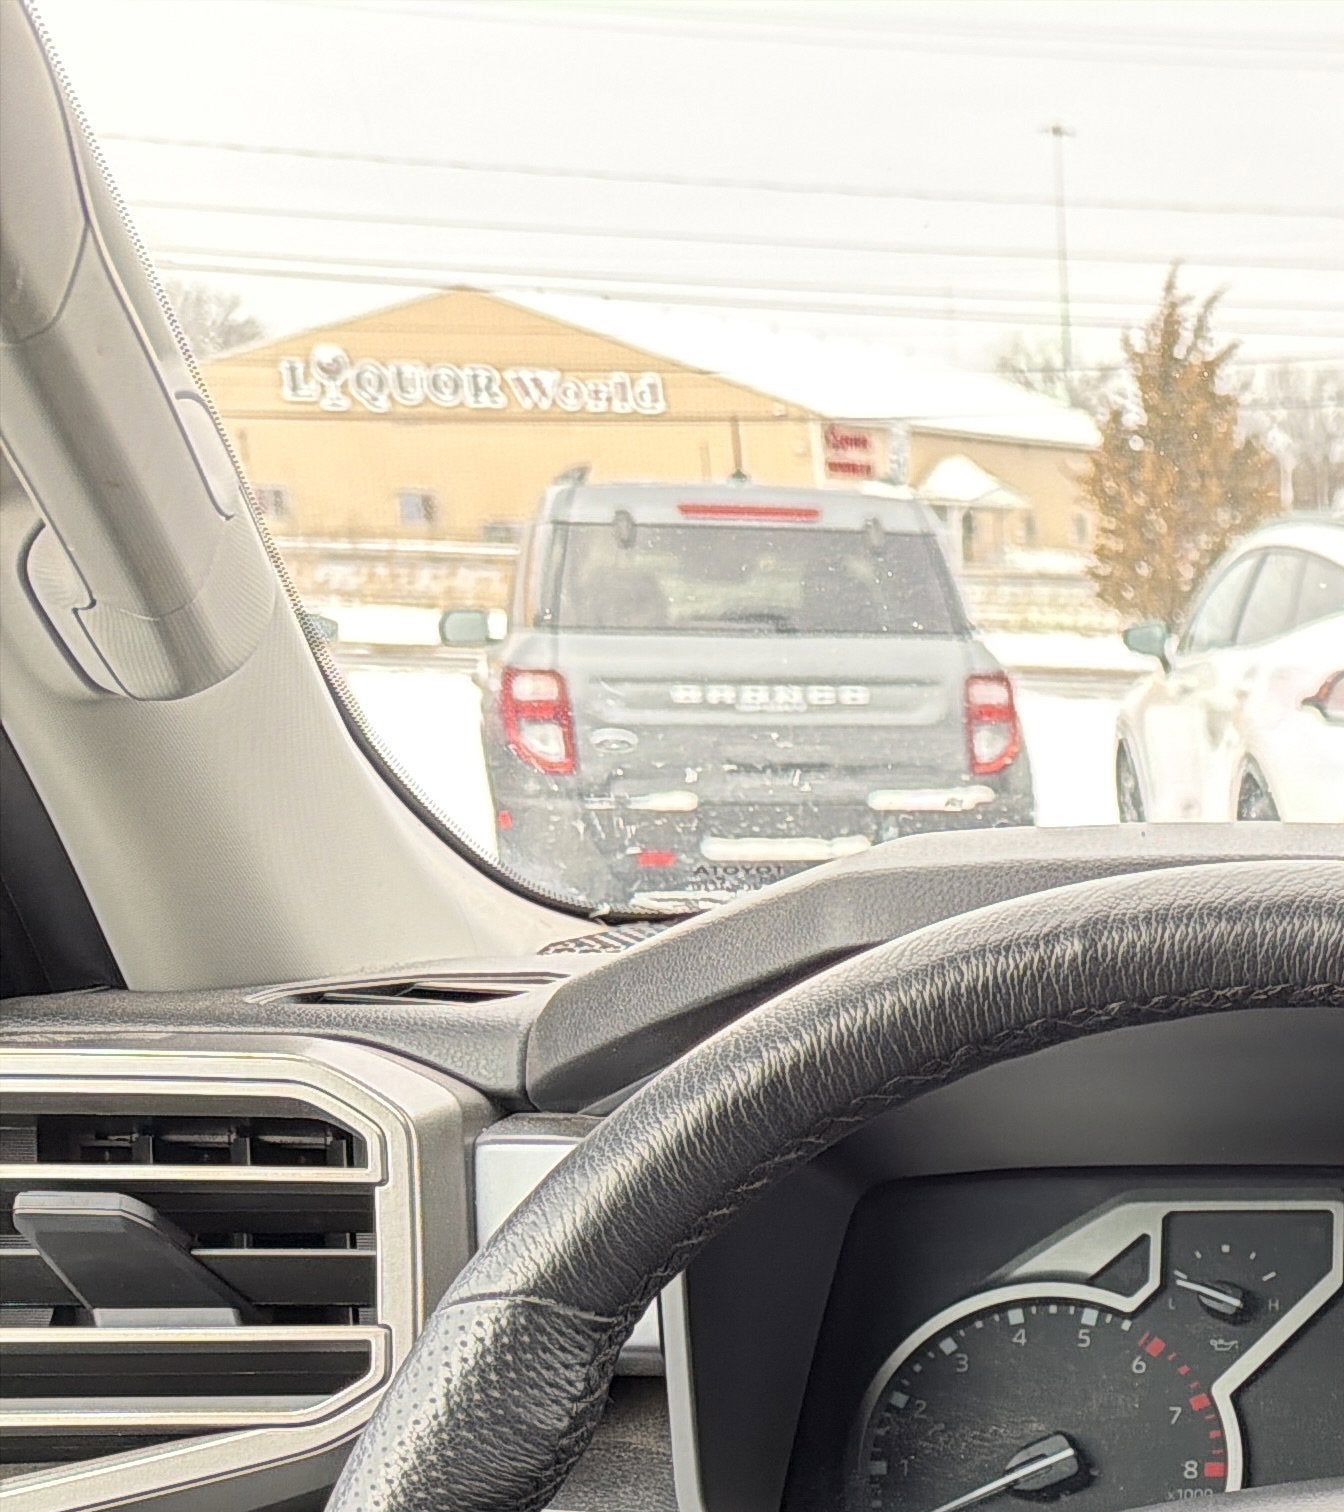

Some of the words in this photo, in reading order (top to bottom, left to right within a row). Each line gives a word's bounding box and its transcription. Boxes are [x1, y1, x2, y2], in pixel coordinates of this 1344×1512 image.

[1269, 1299, 1280, 1311] H
[1012, 1329, 1027, 1346] 4
[1077, 1329, 1091, 1348] 5
[955, 1355, 969, 1373] 3
[1131, 1356, 1147, 1374] 6
[914, 1400, 927, 1419] 2
[1169, 1406, 1182, 1425] 7
[1183, 1460, 1198, 1479] 8
